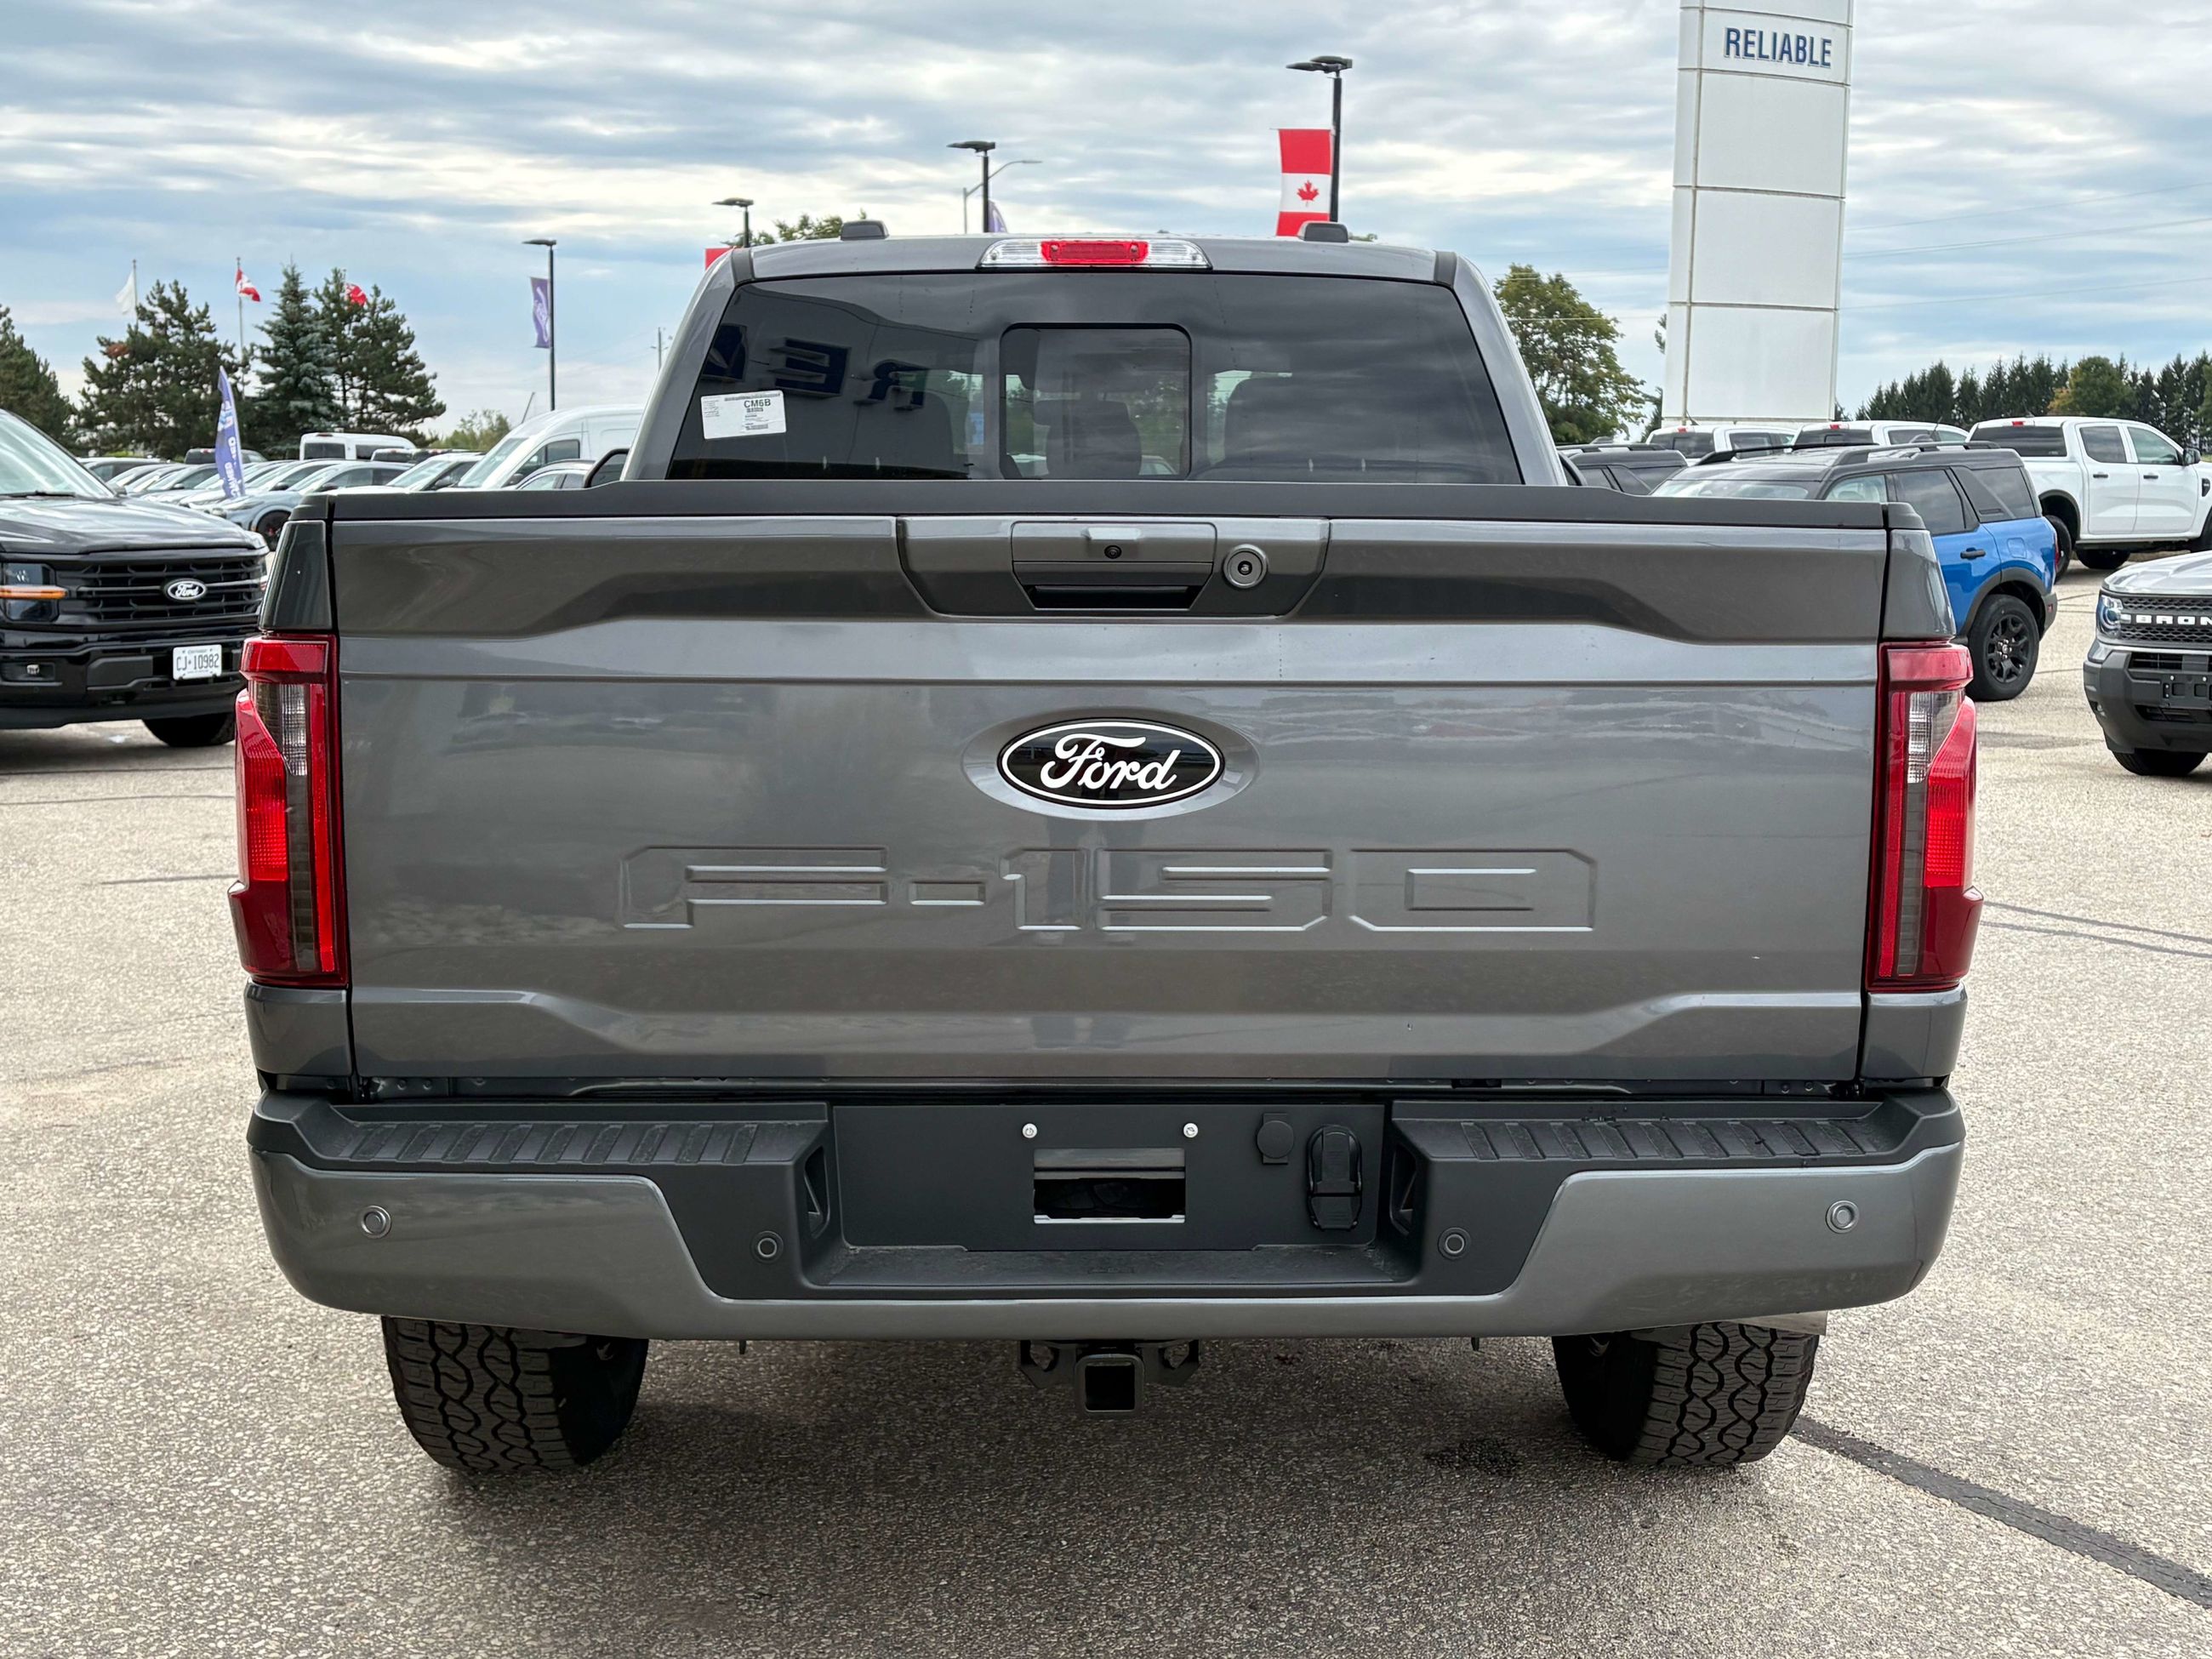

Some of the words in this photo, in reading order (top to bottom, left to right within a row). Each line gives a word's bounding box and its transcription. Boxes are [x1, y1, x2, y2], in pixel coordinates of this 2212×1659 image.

[1725, 27, 1832, 67] RELIABLE
[744, 398, 771, 408] CM6B
[1040, 733, 1182, 790] Ford
[620, 846, 1595, 932] F-150
